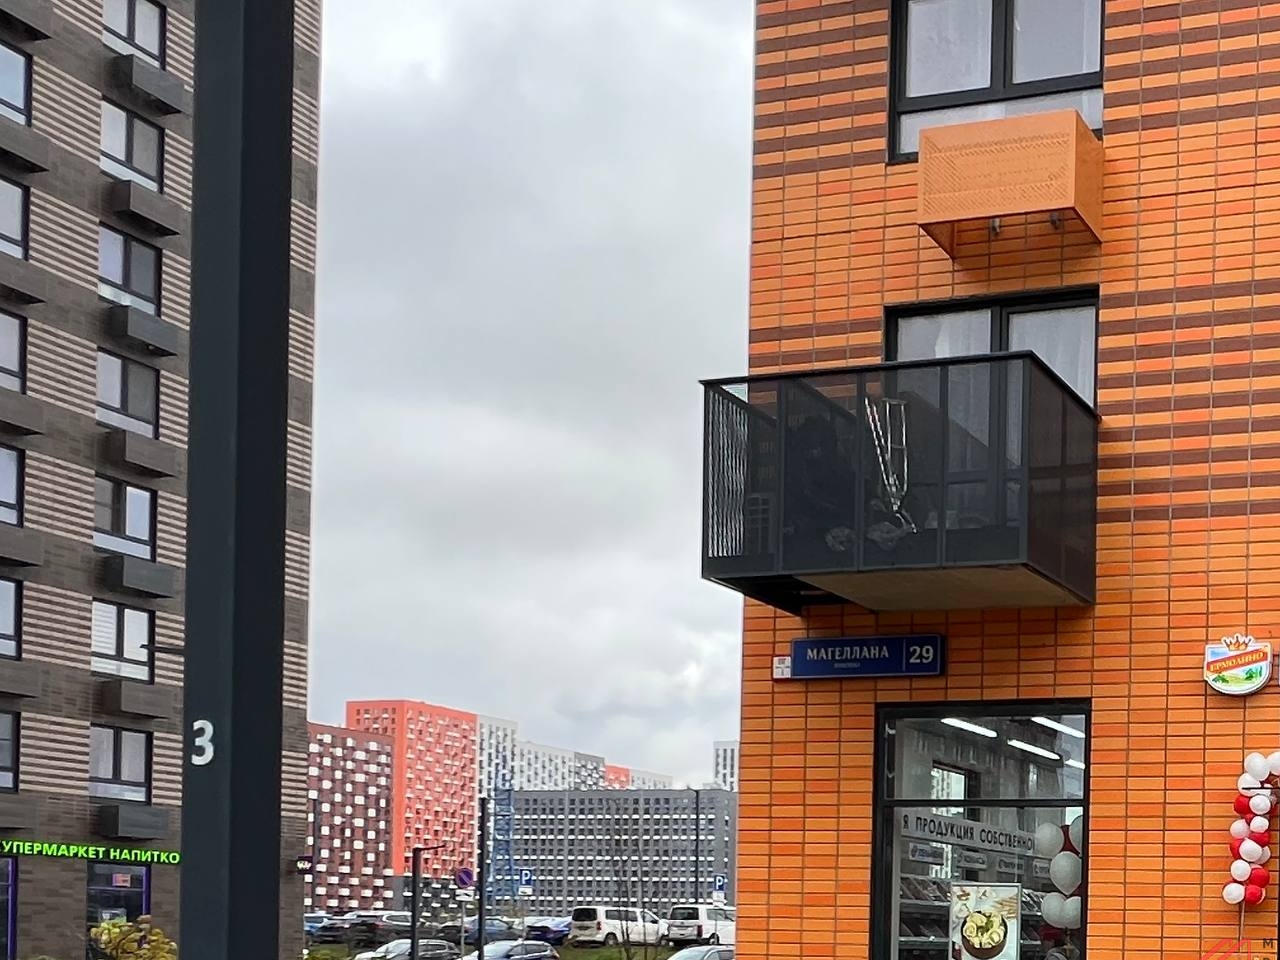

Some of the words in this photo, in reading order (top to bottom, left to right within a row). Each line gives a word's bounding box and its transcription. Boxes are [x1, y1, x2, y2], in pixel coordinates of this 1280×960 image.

[806, 645, 889, 661] МАГЕЛЛАНА
[908, 645, 934, 664] 29
[191, 719, 214, 765] 3
[915, 816, 974, 841] ПРОДУКЦИЯ
[979, 828, 1035, 852] СОБСТВЕННО
[0, 840, 106, 860] УПЕРМАРКЕТ
